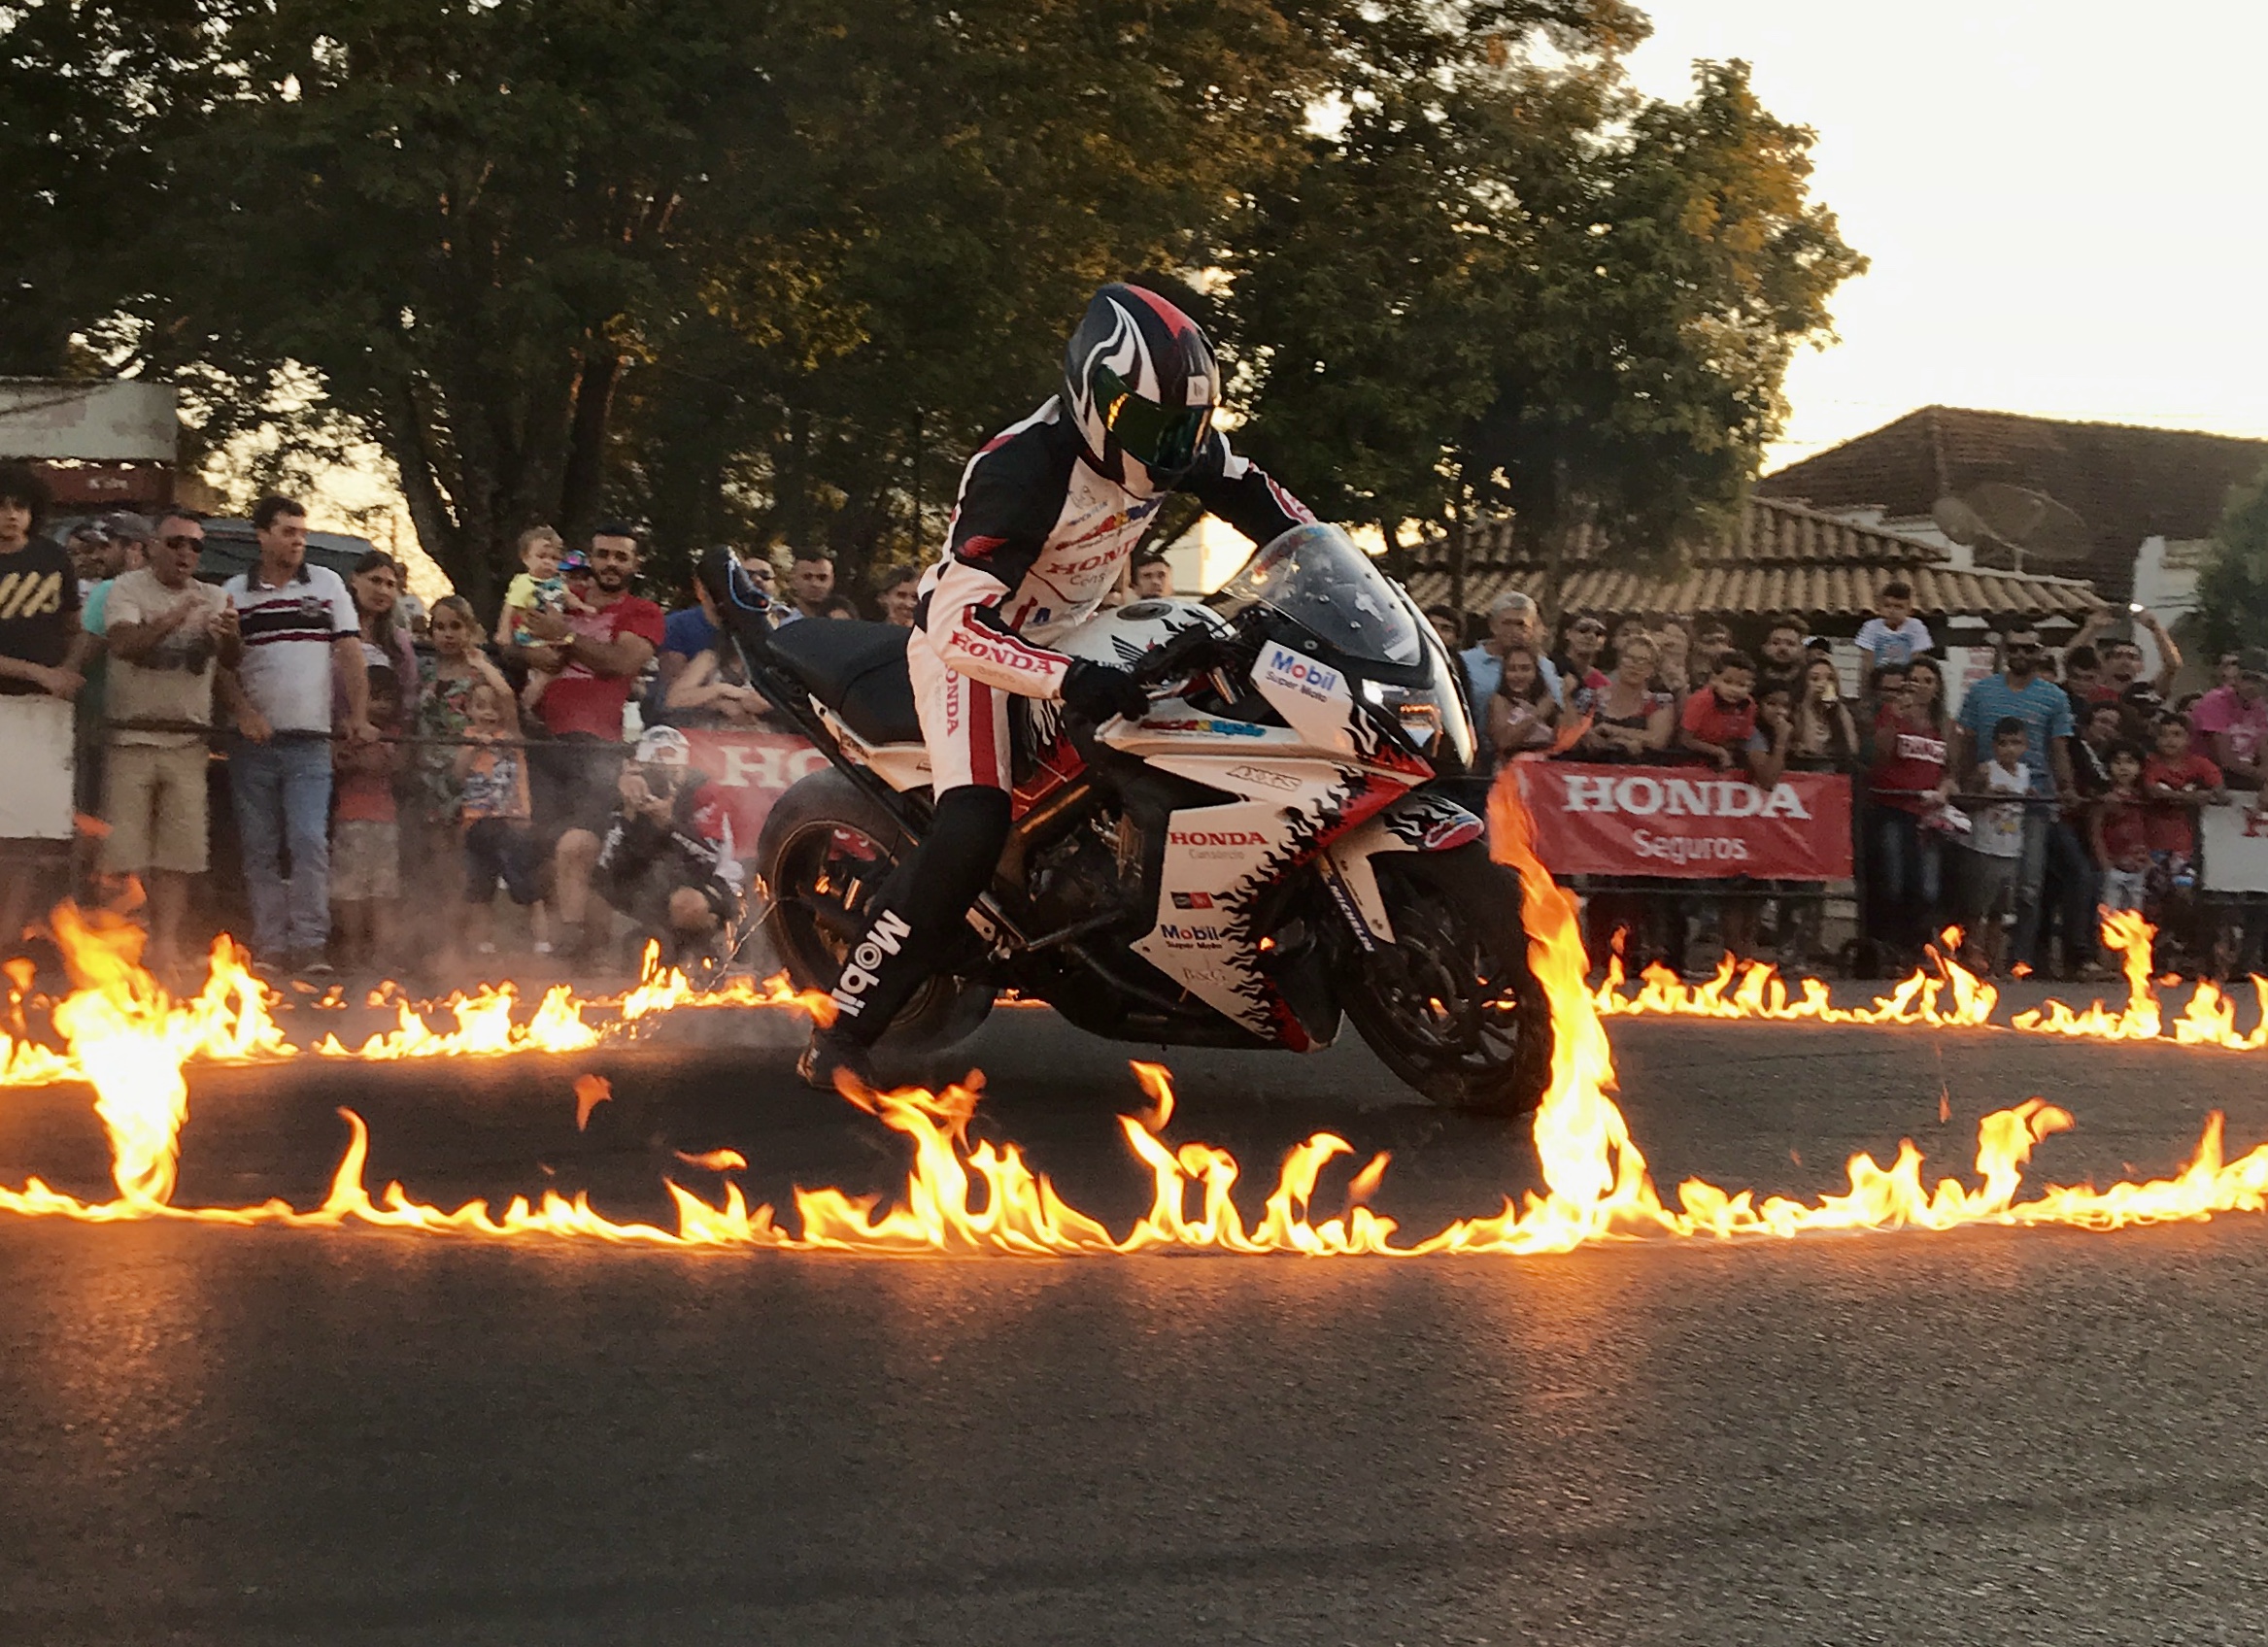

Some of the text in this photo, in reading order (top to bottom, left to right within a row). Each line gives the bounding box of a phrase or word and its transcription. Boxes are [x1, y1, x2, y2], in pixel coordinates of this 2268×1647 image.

[949, 630, 1056, 675] HONDA
[1270, 651, 1337, 690] Mobil
[1266, 671, 1299, 689] Super
[944, 663, 960, 738] ONDA
[1561, 775, 1813, 820] HONDA
[1170, 831, 1269, 846] HONDA
[1633, 828, 1748, 864] Seguros
[1161, 924, 1220, 940] Mobil
[830, 909, 912, 1017] Mobil
